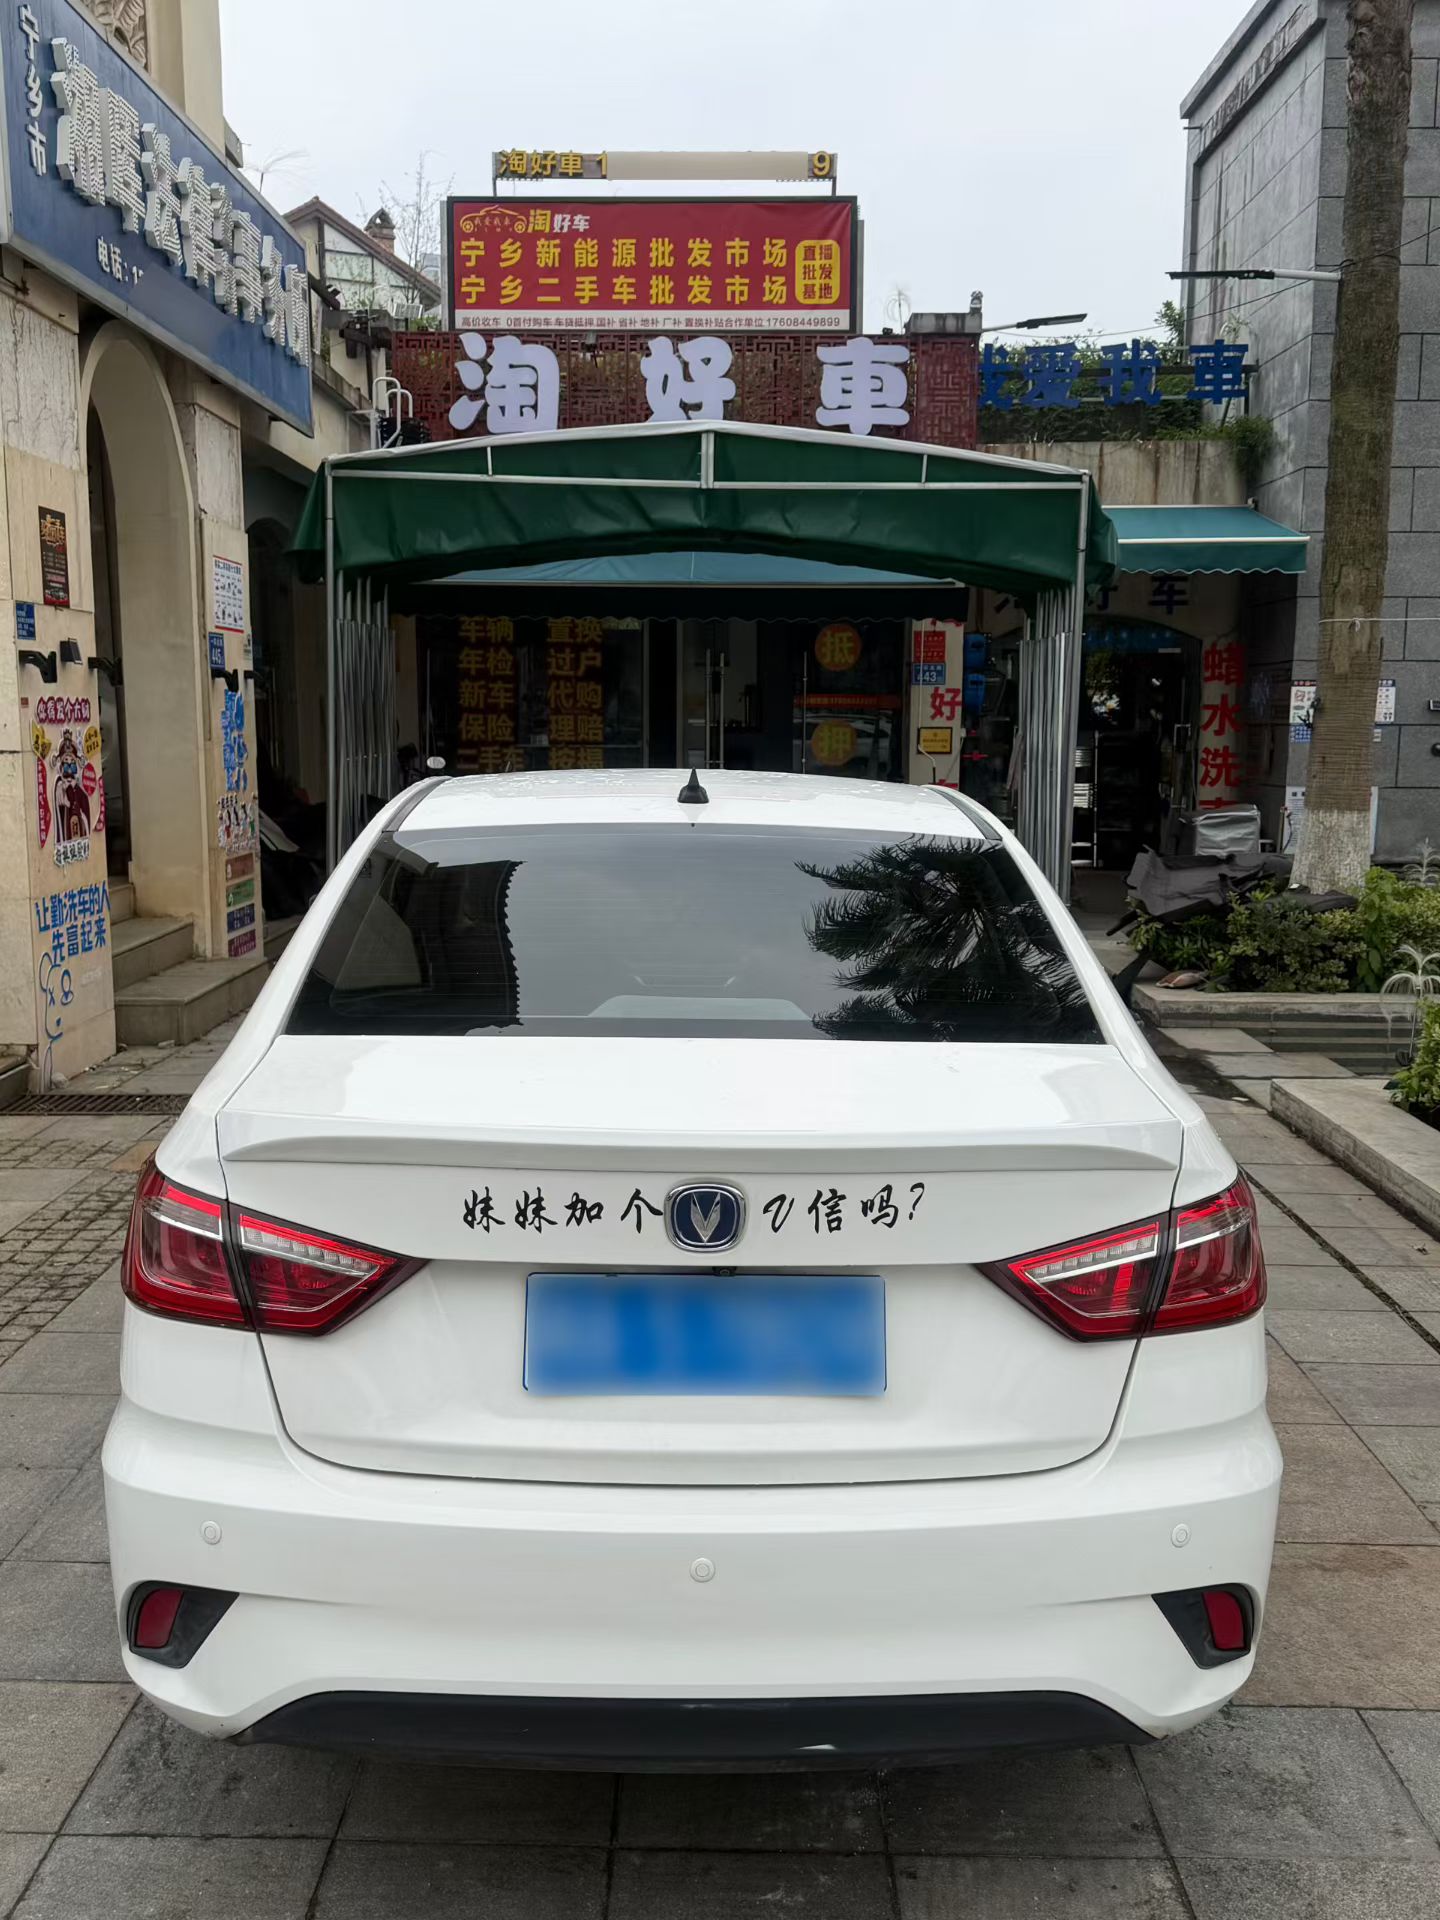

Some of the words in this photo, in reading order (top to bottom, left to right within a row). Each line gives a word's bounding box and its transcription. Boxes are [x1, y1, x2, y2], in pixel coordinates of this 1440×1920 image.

[20, 4, 46, 176] 宁乡市
[499, 148, 583, 176] 淘好車
[527, 208, 590, 233] 淘好车
[460, 237, 788, 268] 宁乡新能源批发市场
[803, 244, 833, 261] 直播
[803, 264, 833, 280] 批发
[460, 274, 788, 305] 宁乡二手车批发市场
[803, 283, 833, 300] 基地
[766, 317, 841, 328] 17608449899
[449, 332, 911, 437] 淘好車
[457, 679, 516, 709] 新车
[457, 713, 516, 742] 保险
[35, 880, 111, 933] 让勤洗车的人
[52, 916, 106, 962] 先富起来
[463, 1186, 664, 1234] 妹妹加个
